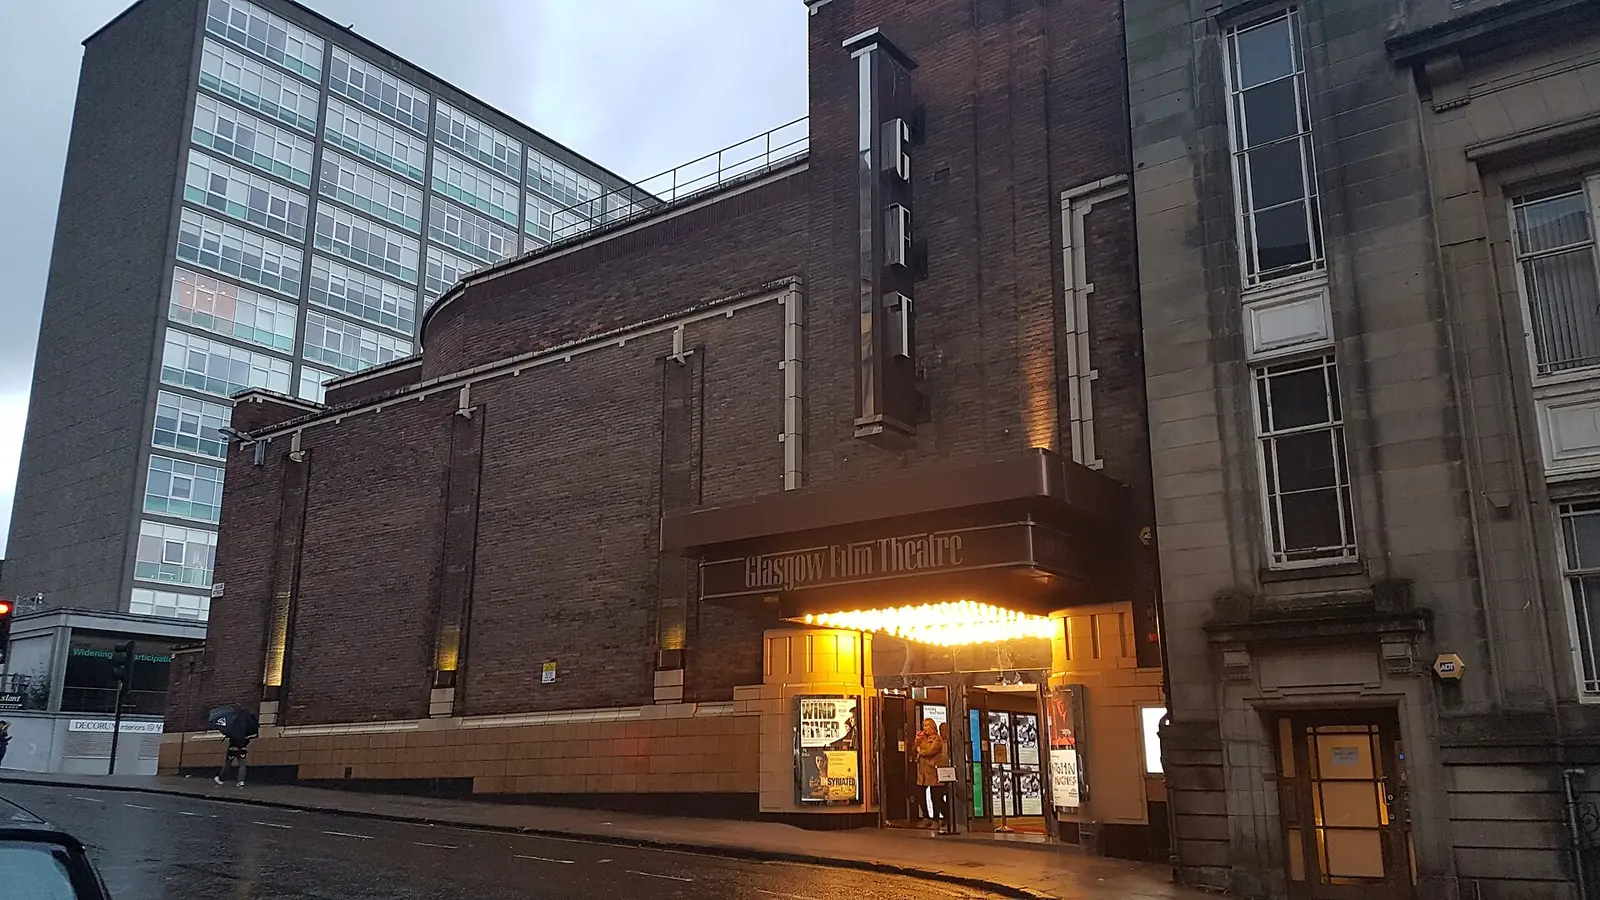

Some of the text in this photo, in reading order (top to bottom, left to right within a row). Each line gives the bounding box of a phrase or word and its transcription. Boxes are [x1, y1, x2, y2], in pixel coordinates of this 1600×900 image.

[745, 534, 963, 592] Glasgow Film Theatre
[73, 648, 113, 660] Widening
[1440, 662, 1456, 671] ADT
[802, 702, 836, 720] WIND
[802, 721, 840, 738] RIVER
